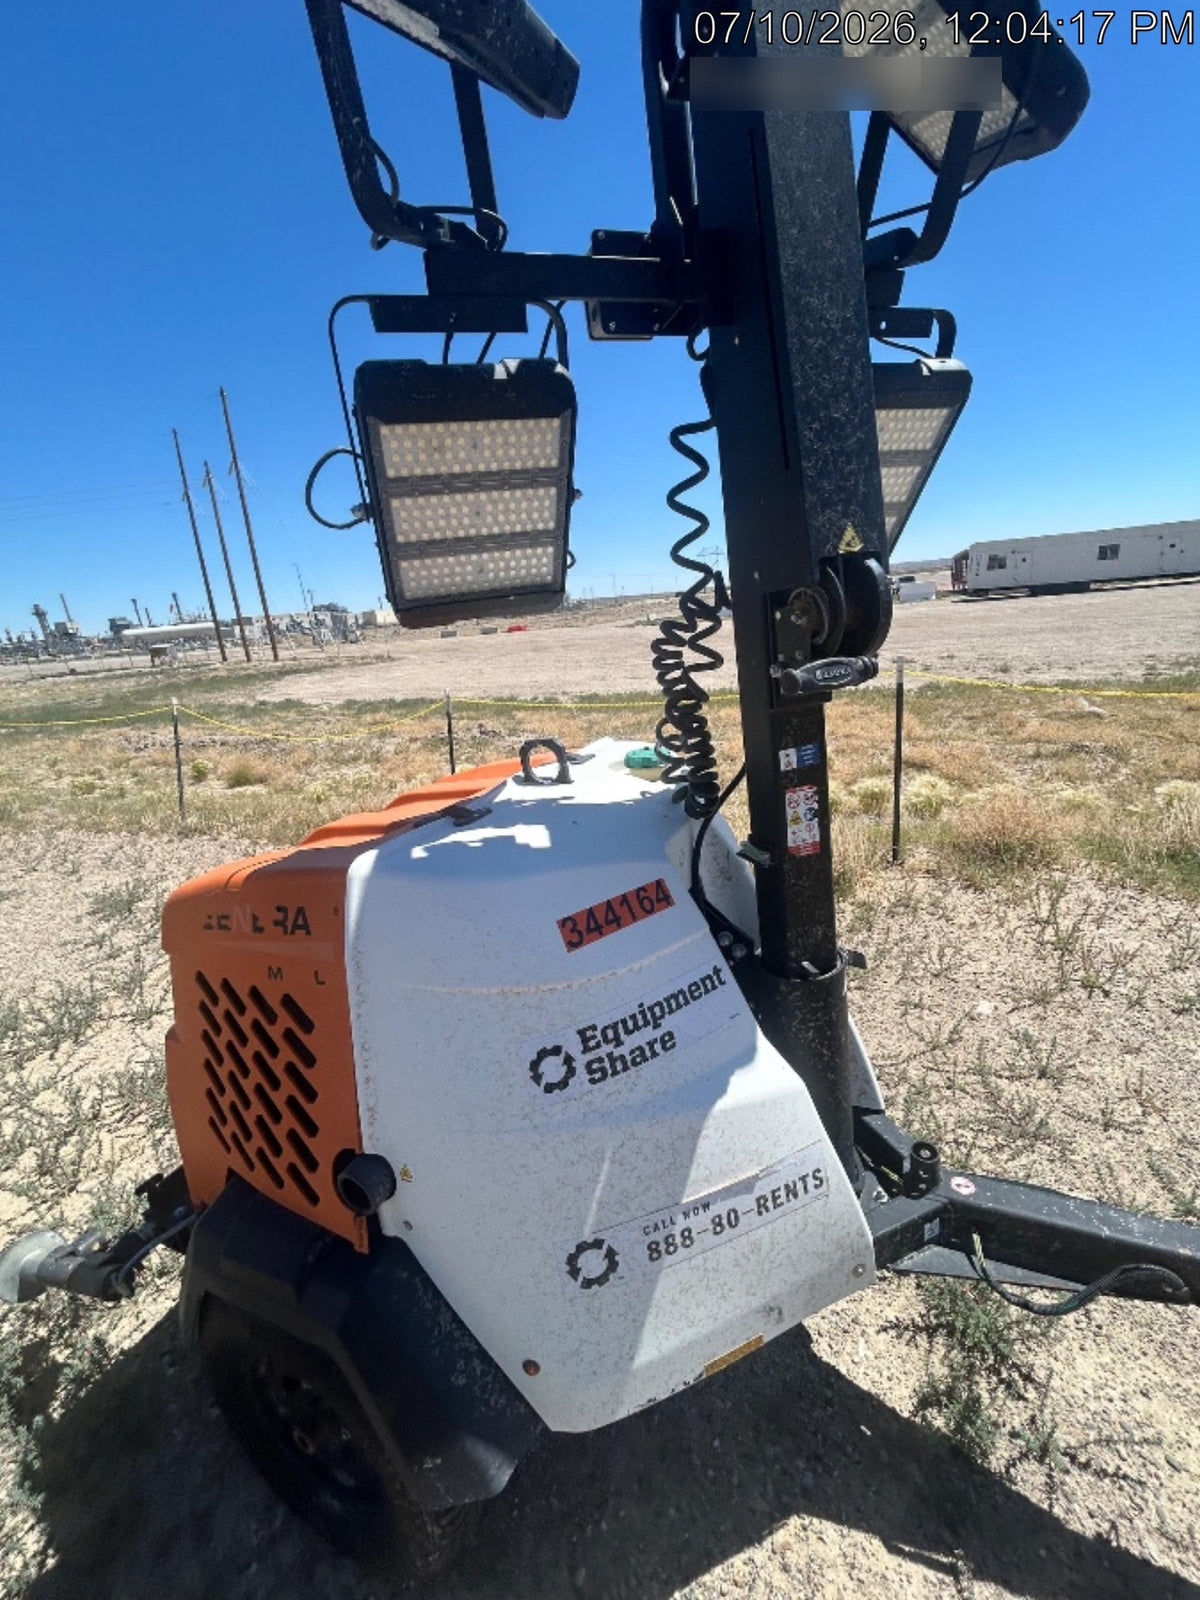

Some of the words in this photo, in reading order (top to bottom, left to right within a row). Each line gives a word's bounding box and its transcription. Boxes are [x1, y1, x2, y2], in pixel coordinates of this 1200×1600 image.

[560, 879, 675, 949] 344164
[576, 964, 727, 1056] Equipment
[584, 1029, 677, 1086] Share
[642, 1215, 677, 1236] CALL
[682, 1201, 712, 1221] NOW
[646, 1167, 825, 1263] 888-80-RENTS
